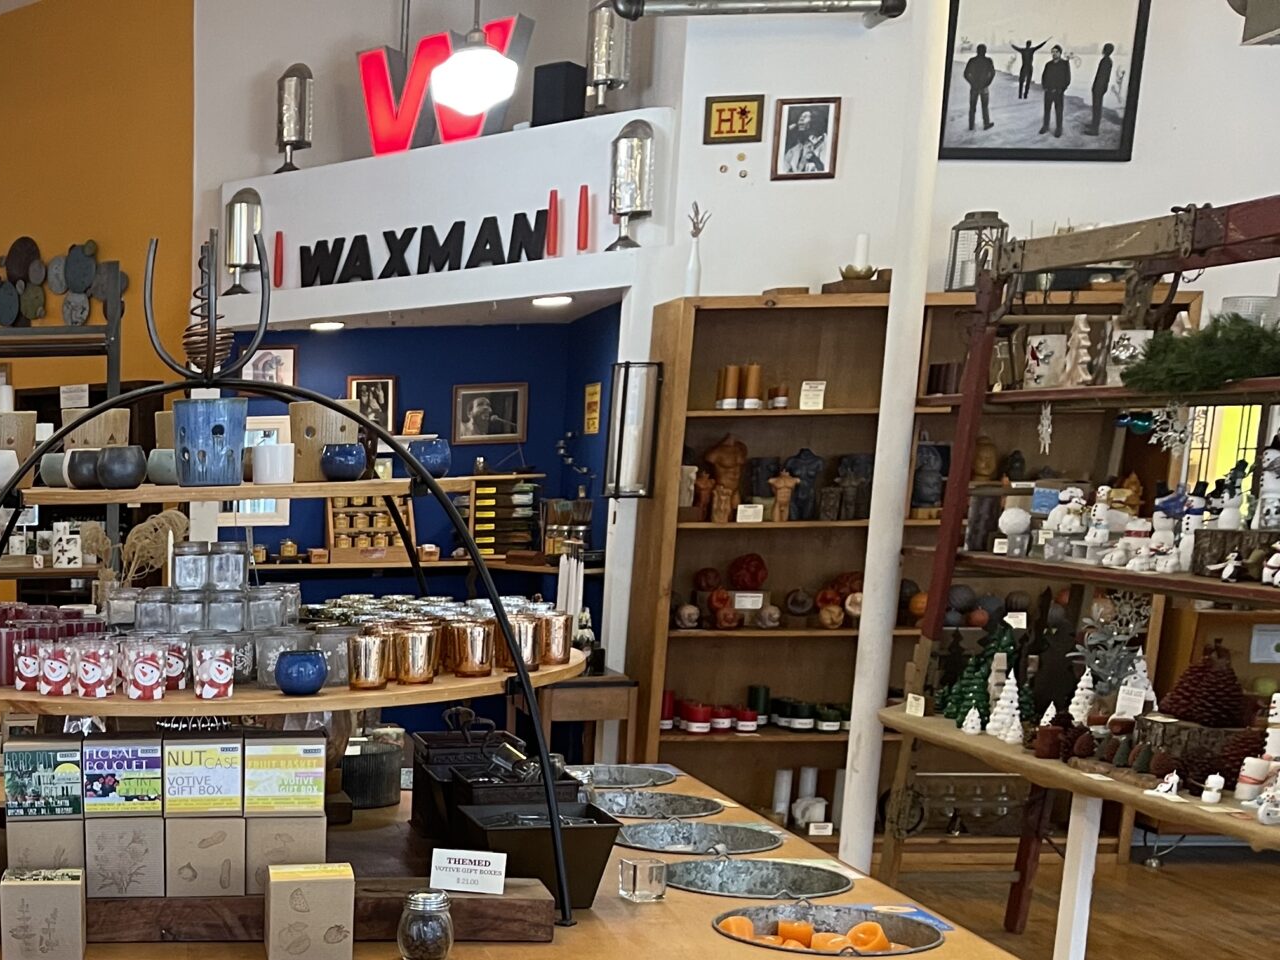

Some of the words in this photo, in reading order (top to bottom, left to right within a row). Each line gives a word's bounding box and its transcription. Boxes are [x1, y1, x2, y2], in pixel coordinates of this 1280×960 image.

[358, 15, 522, 158] W
[714, 105, 751, 134] Hi
[299, 209, 549, 289] WAXMAN
[86, 748, 136, 760] FLORAL
[168, 750, 207, 767] NUT
[204, 757, 238, 770] CASE
[86, 760, 148, 772] BOUQUET
[167, 776, 211, 786] VOTIVE
[167, 786, 194, 796] GIFT
[198, 785, 223, 795] BOX
[447, 857, 491, 868] THEMED
[435, 865, 461, 873] VOTIVE
[461, 867, 478, 875] GIFT
